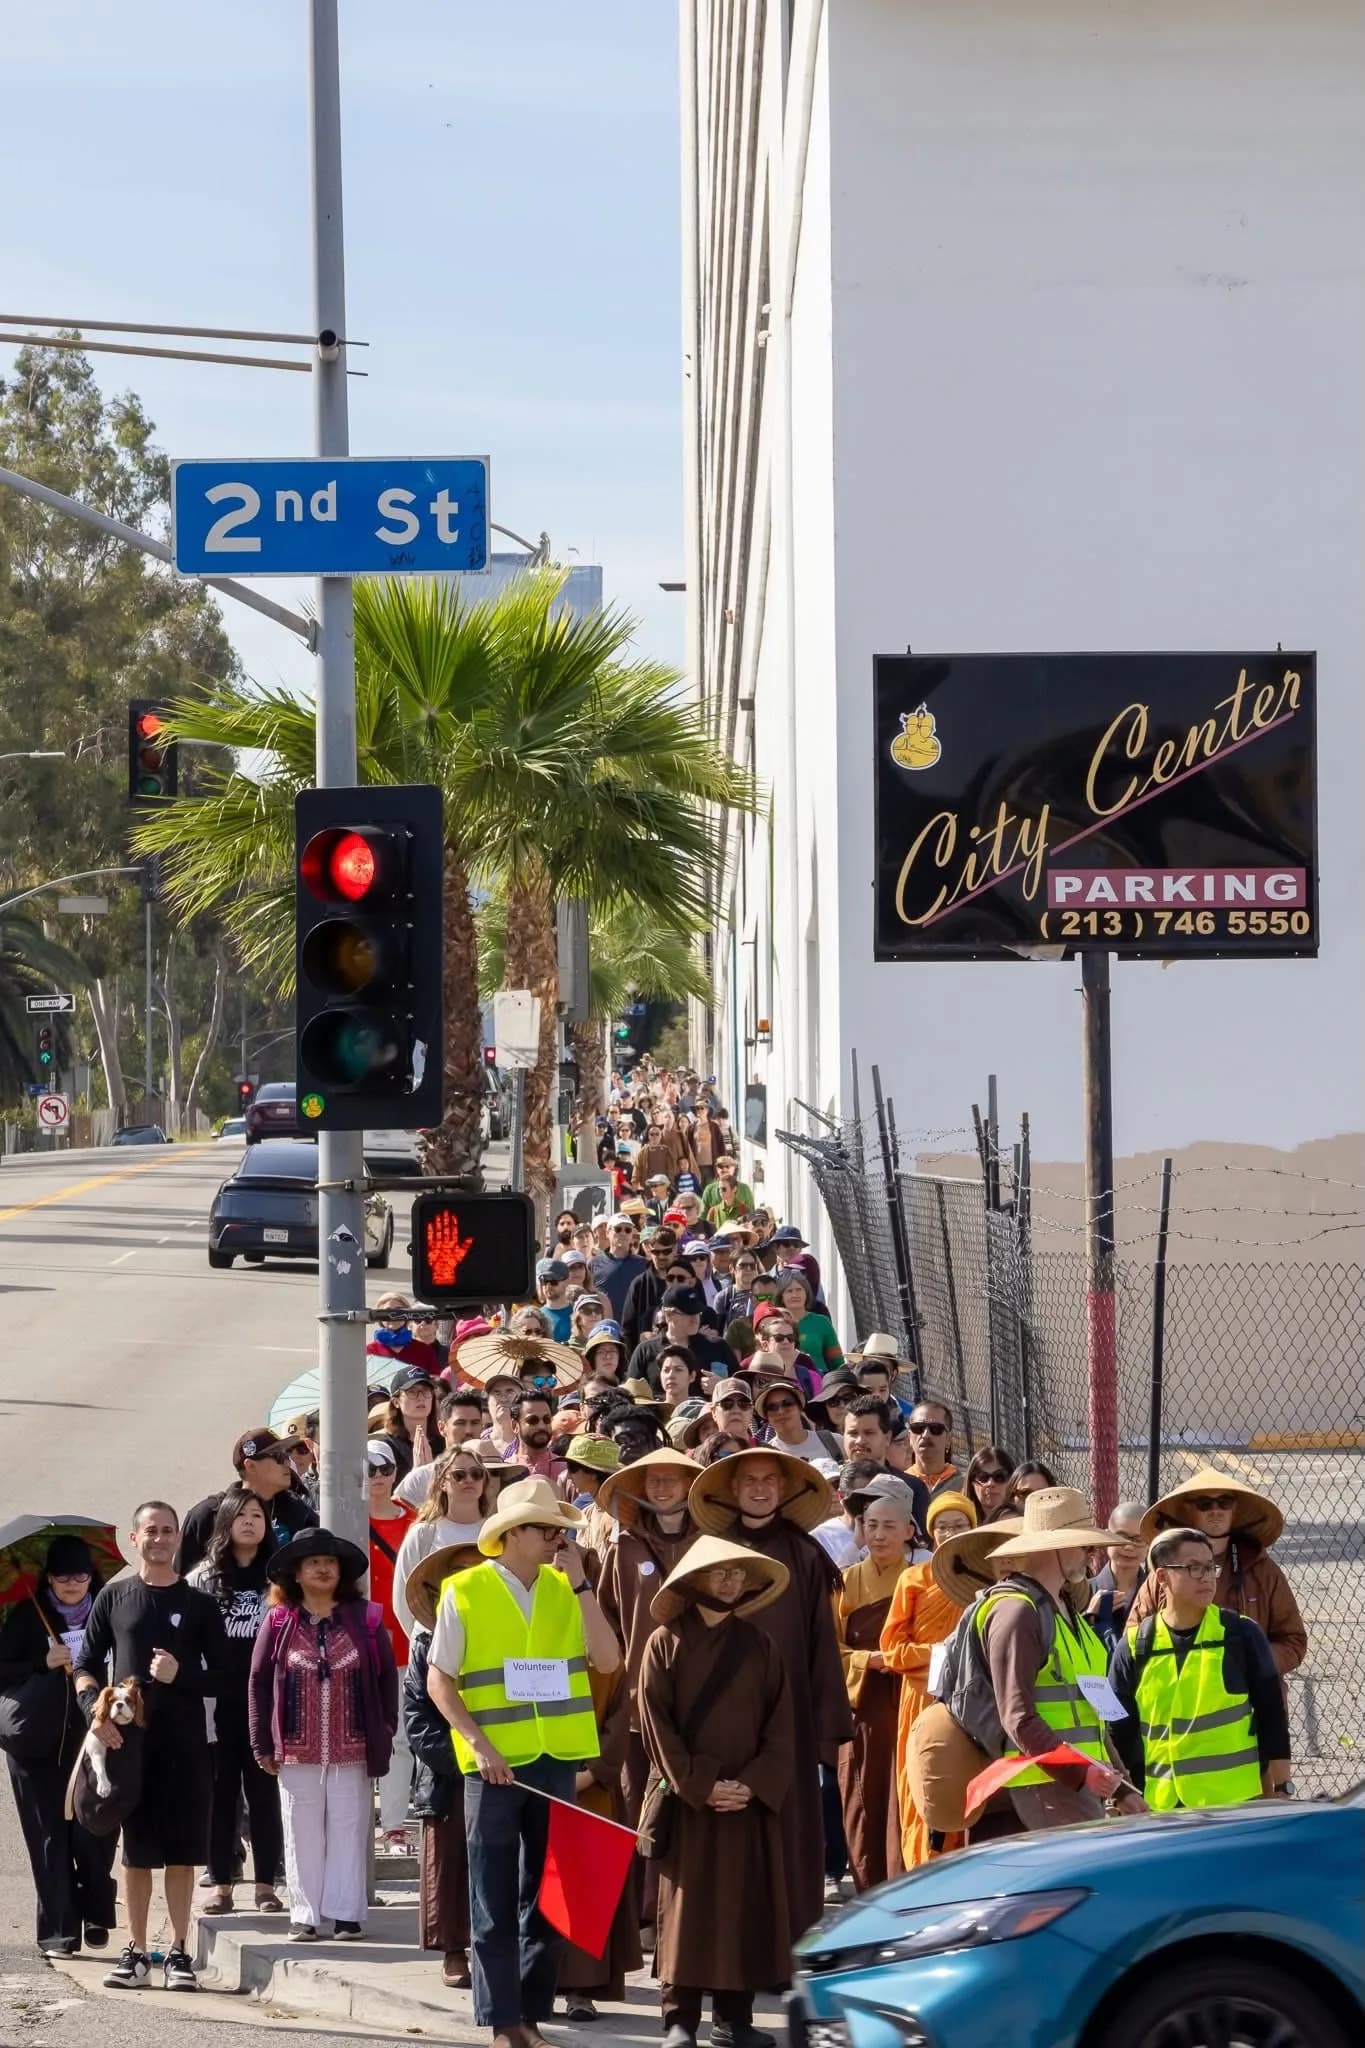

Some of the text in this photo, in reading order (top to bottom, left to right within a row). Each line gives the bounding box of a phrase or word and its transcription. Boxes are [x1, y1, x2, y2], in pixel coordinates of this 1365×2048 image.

[205, 480, 337, 552] 2nd
[375, 488, 459, 546] St
[895, 668, 1301, 926] City Center
[1055, 873, 1298, 903] PARKING
[1153, 911, 1216, 936] 746
[1227, 911, 1310, 936] 5550
[513, 1662, 556, 1671] Volunteer
